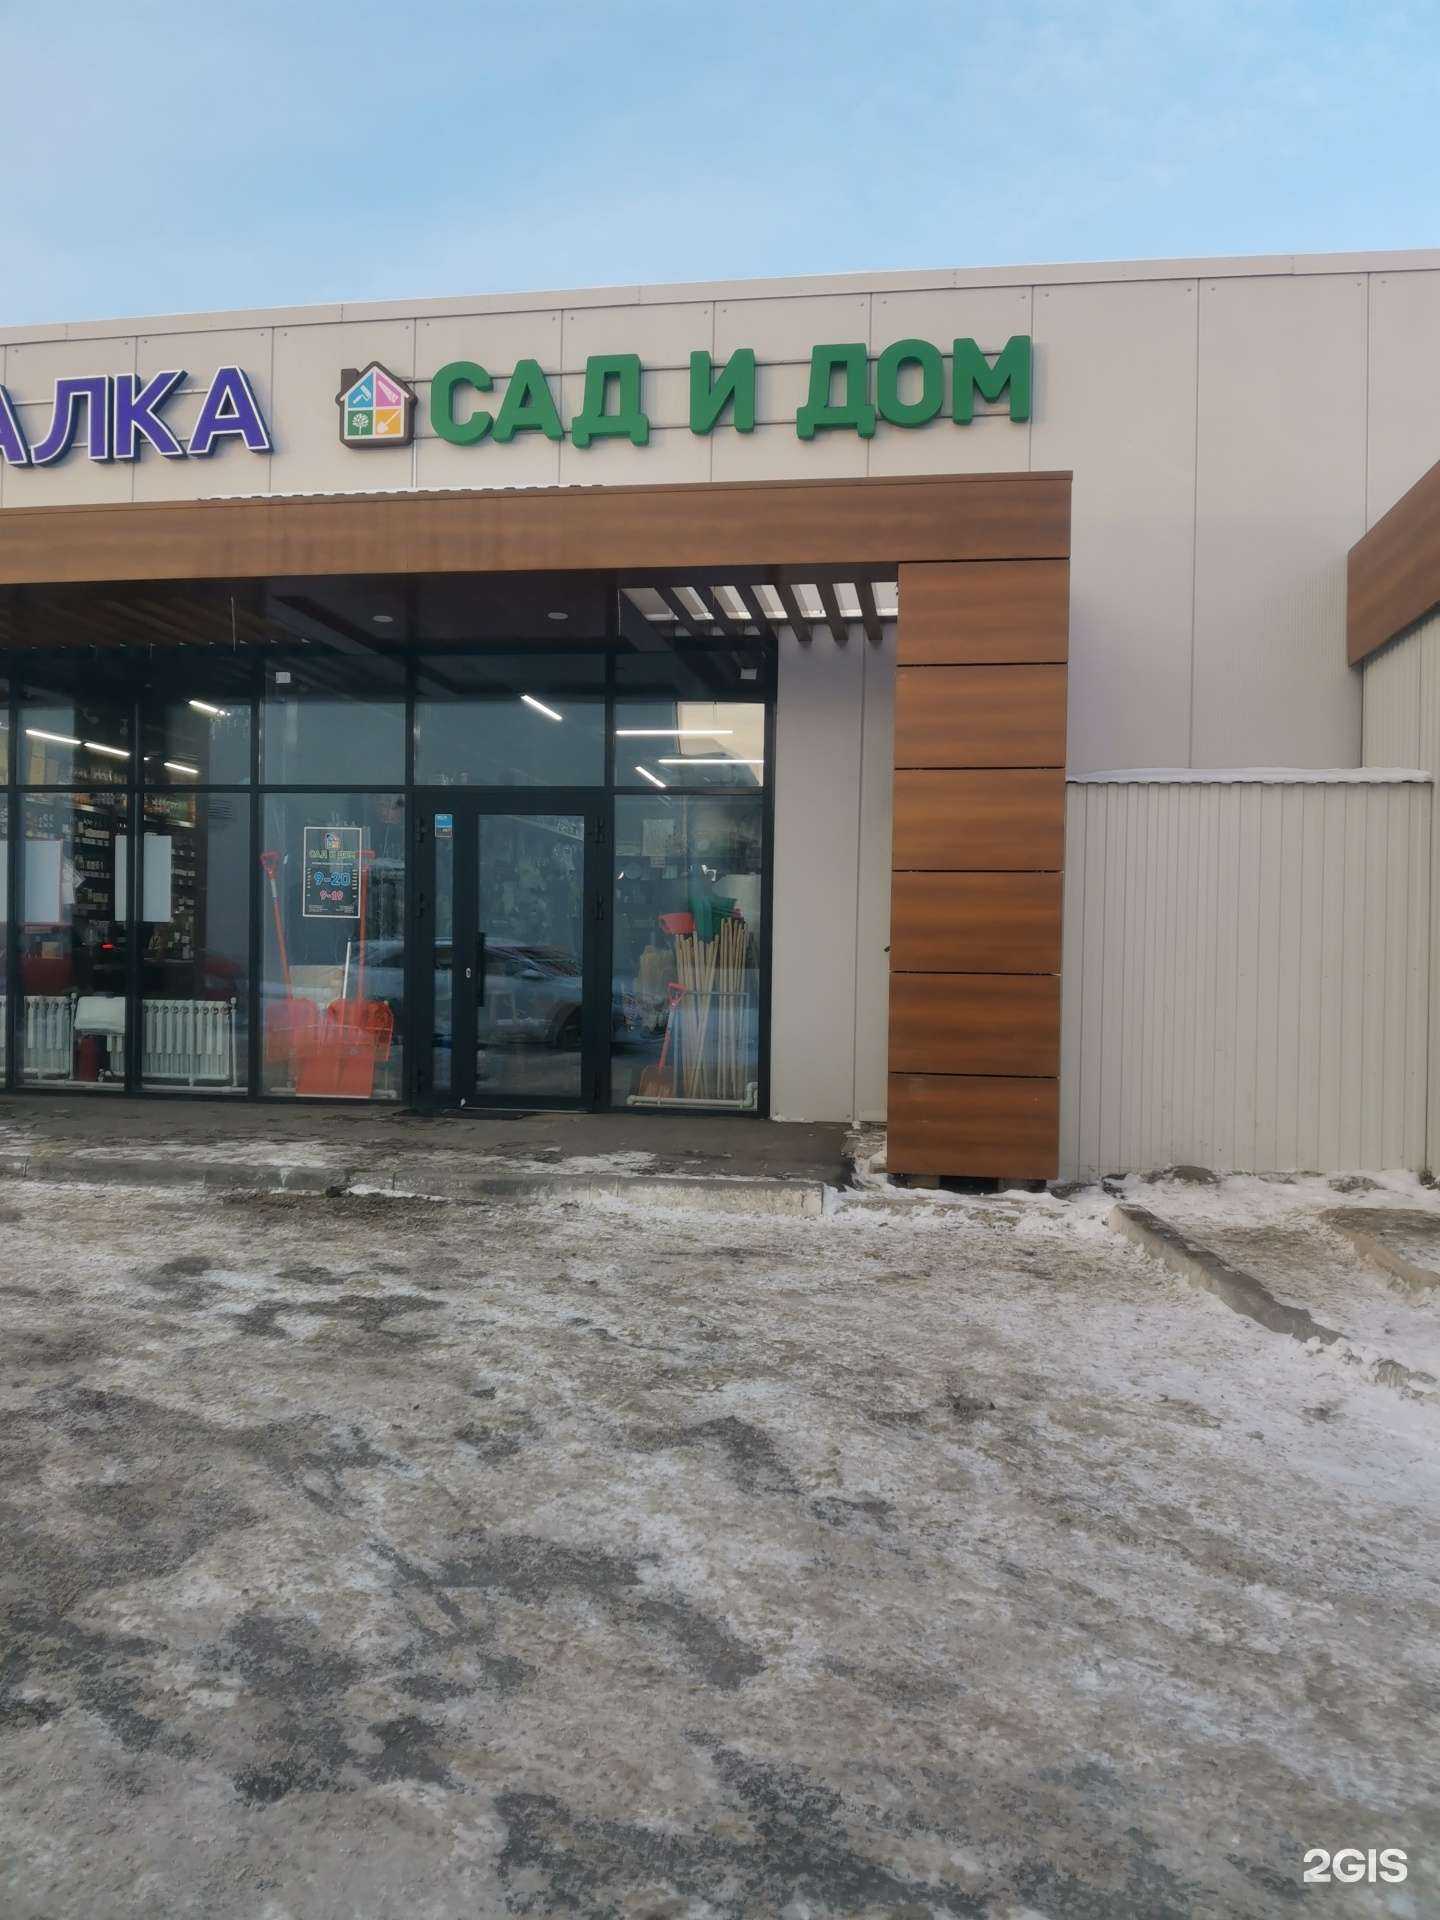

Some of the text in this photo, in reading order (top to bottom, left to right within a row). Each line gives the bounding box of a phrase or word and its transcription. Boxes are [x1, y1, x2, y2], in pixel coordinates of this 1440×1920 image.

[431, 335, 1032, 449] САД И ДОМ
